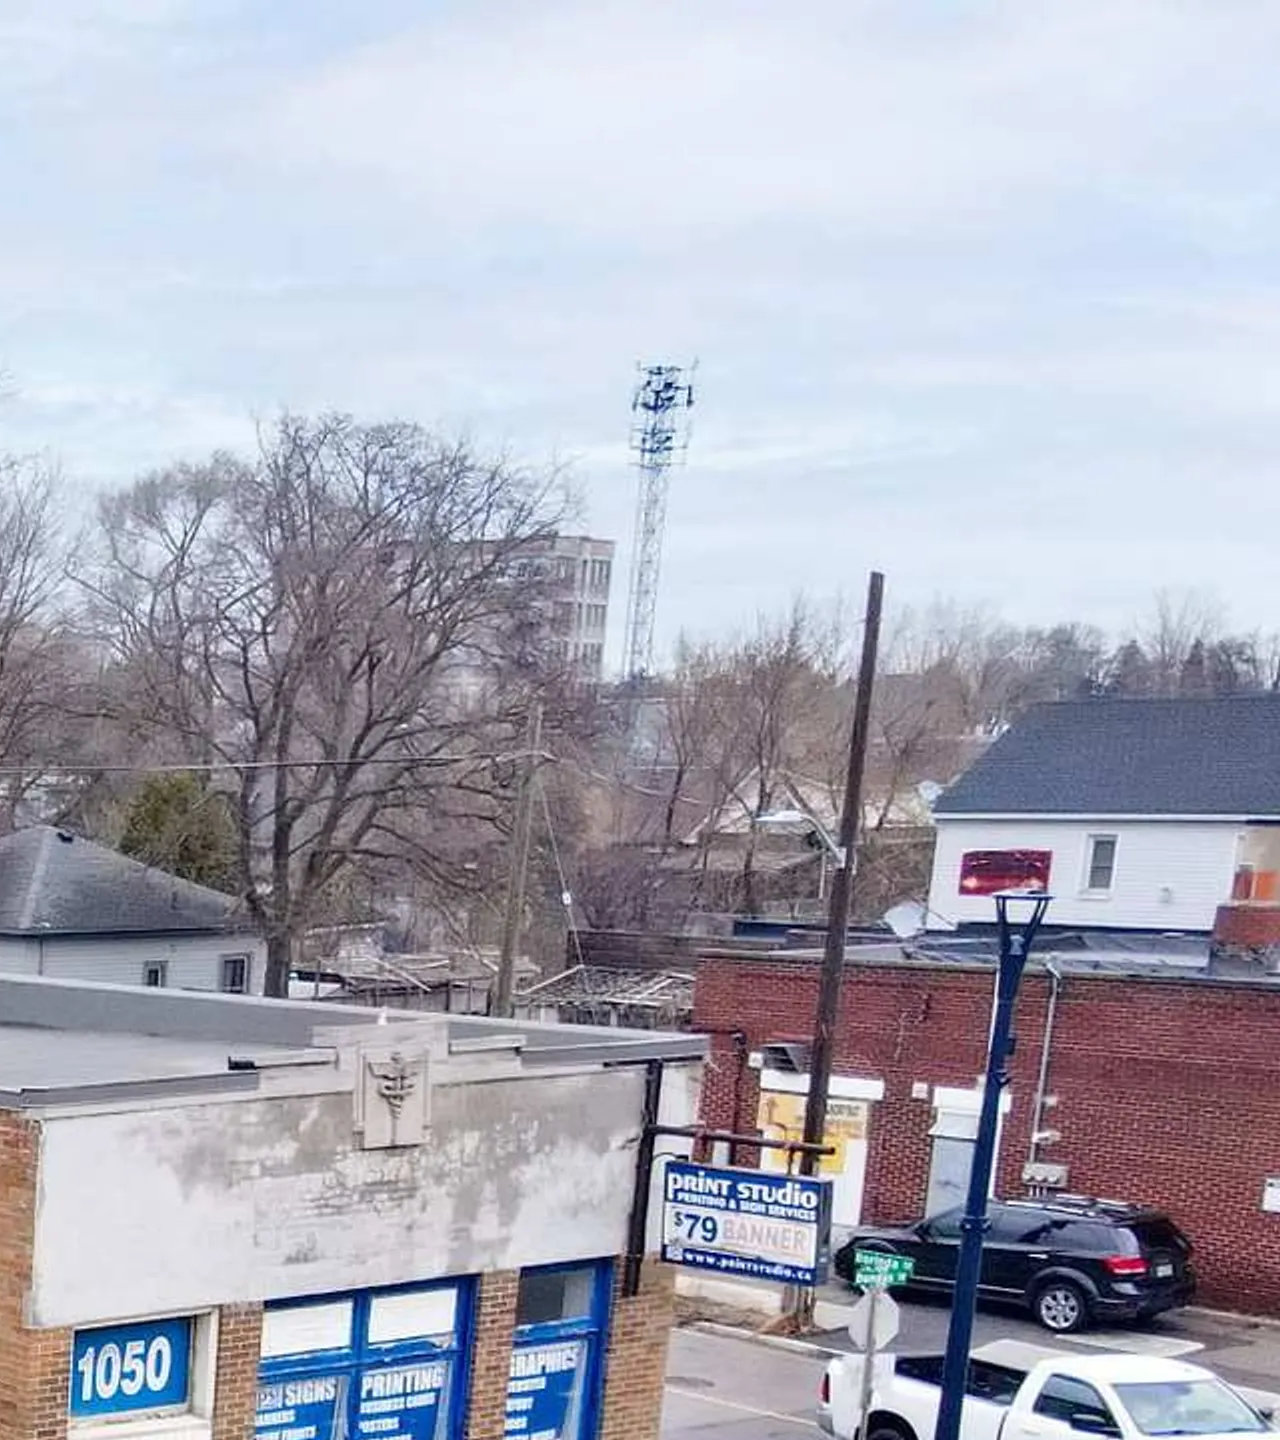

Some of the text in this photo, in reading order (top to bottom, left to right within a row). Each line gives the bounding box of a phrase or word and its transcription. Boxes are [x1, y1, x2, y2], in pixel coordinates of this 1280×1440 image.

[676, 1191, 726, 1209] PRINTING
[740, 1200, 766, 1213] SIGN
[767, 1203, 817, 1221] SERVICES
[673, 1211, 807, 1251] $79 BANNER
[78, 1336, 172, 1402] 1050
[360, 1367, 445, 1399] PRINTING
[284, 1376, 338, 1406] SIGNS
